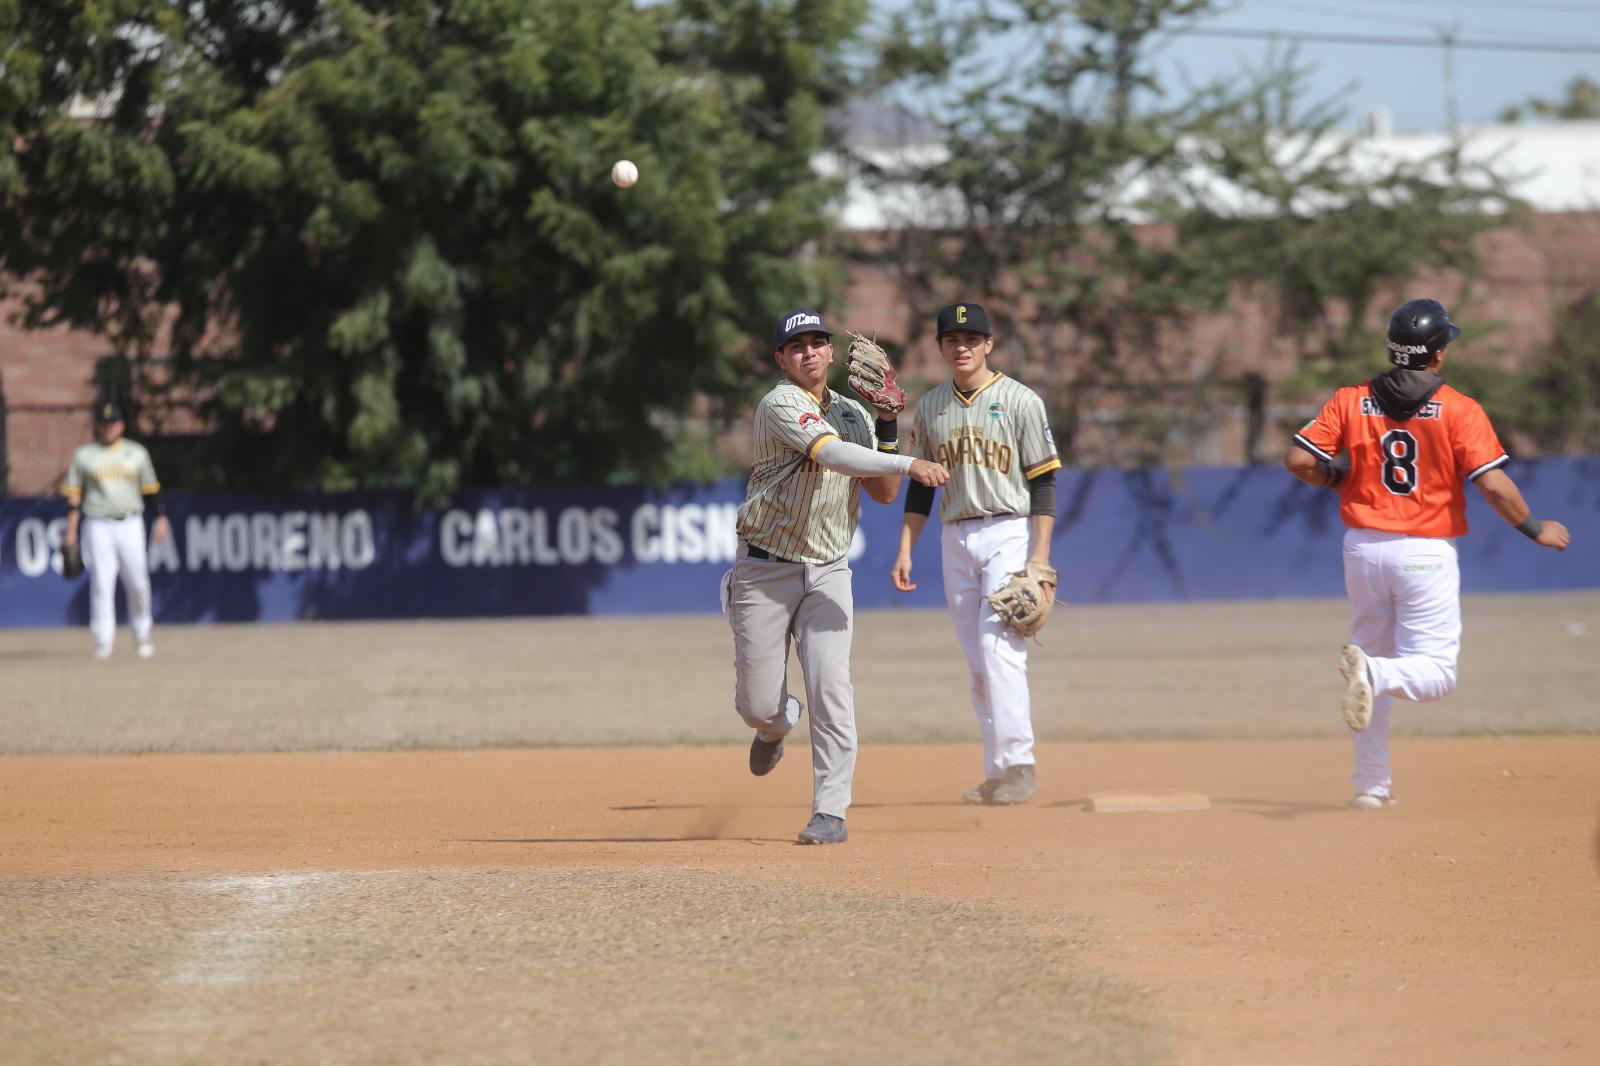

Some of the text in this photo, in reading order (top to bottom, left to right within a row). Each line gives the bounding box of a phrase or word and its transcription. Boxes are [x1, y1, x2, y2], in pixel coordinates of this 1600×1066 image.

[785, 313, 820, 332] UTCam
[957, 306, 967, 323] C
[1394, 352, 1410, 365] 33
[938, 436, 1012, 475] AMACHO
[1380, 429, 1418, 495] 8
[15, 510, 377, 577] OSA MORENO
[440, 506, 624, 566] CARLOS
